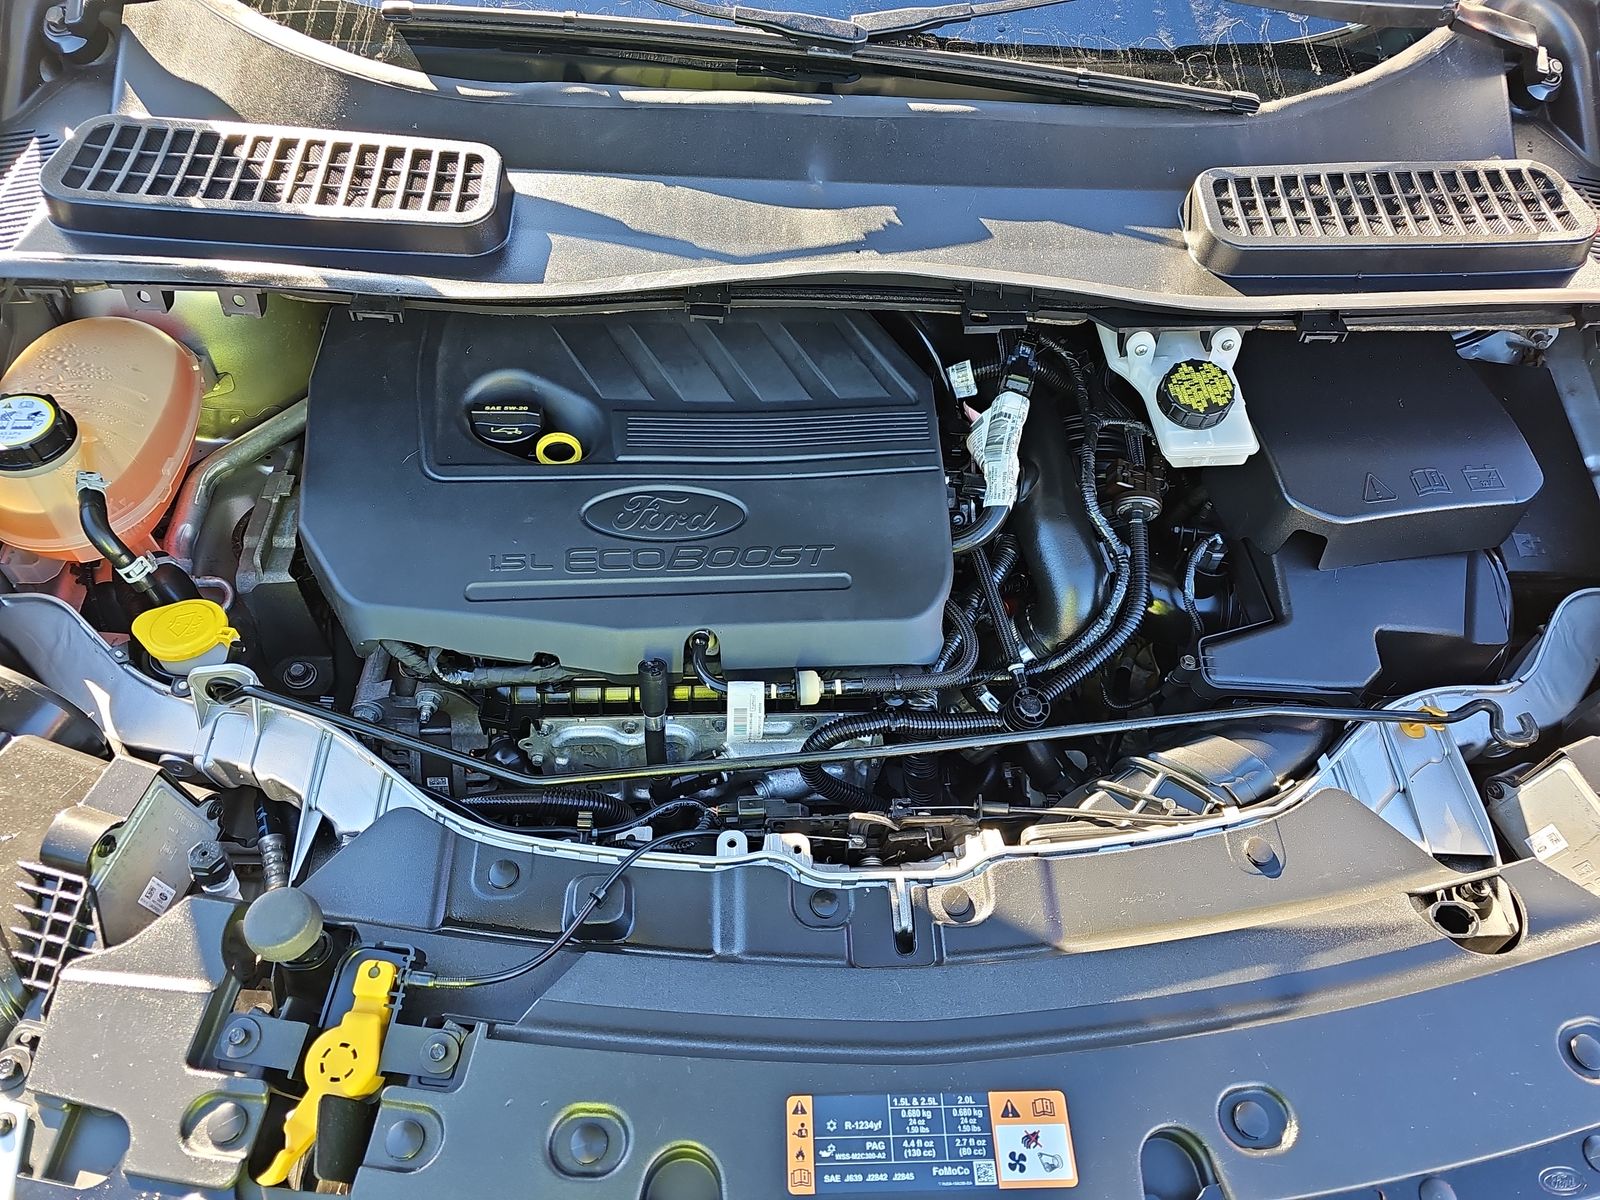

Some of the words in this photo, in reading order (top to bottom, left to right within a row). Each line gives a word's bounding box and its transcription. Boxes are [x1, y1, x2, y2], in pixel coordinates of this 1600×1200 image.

[611, 494, 719, 532] Ford
[488, 554, 554, 573] 1.5L
[564, 543, 836, 575] ECOBOOST
[892, 1097, 911, 1106] 1.5L
[912, 1097, 919, 1106] &
[920, 1096, 939, 1105] 2.5L
[957, 1095, 975, 1104] 2.0L
[901, 1109, 921, 1118] 0.680
[922, 1108, 932, 1119] kg
[952, 1108, 972, 1117] 0.680
[973, 1107, 983, 1118] kg
[844, 1120, 882, 1131] R-1234yf
[908, 1118, 917, 1126] 24
[960, 1117, 968, 1125] 24
[971, 1124, 981, 1132] lbs
[865, 1141, 886, 1150] PAG
[902, 1139, 915, 1148] 4.4
[916, 1139, 922, 1147] fl
[955, 1138, 968, 1147] 2.7
[969, 1138, 975, 1146] fl
[903, 1148, 922, 1158] (130
[922, 1148, 936, 1158] cc)
[959, 1147, 972, 1157] (80
[973, 1147, 986, 1156] cc)
[932, 1165, 970, 1176] FoMoCo
[823, 1174, 841, 1183] SAE
[843, 1173, 863, 1182] J639
[865, 1173, 888, 1182] J2842
[892, 1172, 915, 1181] J2845
